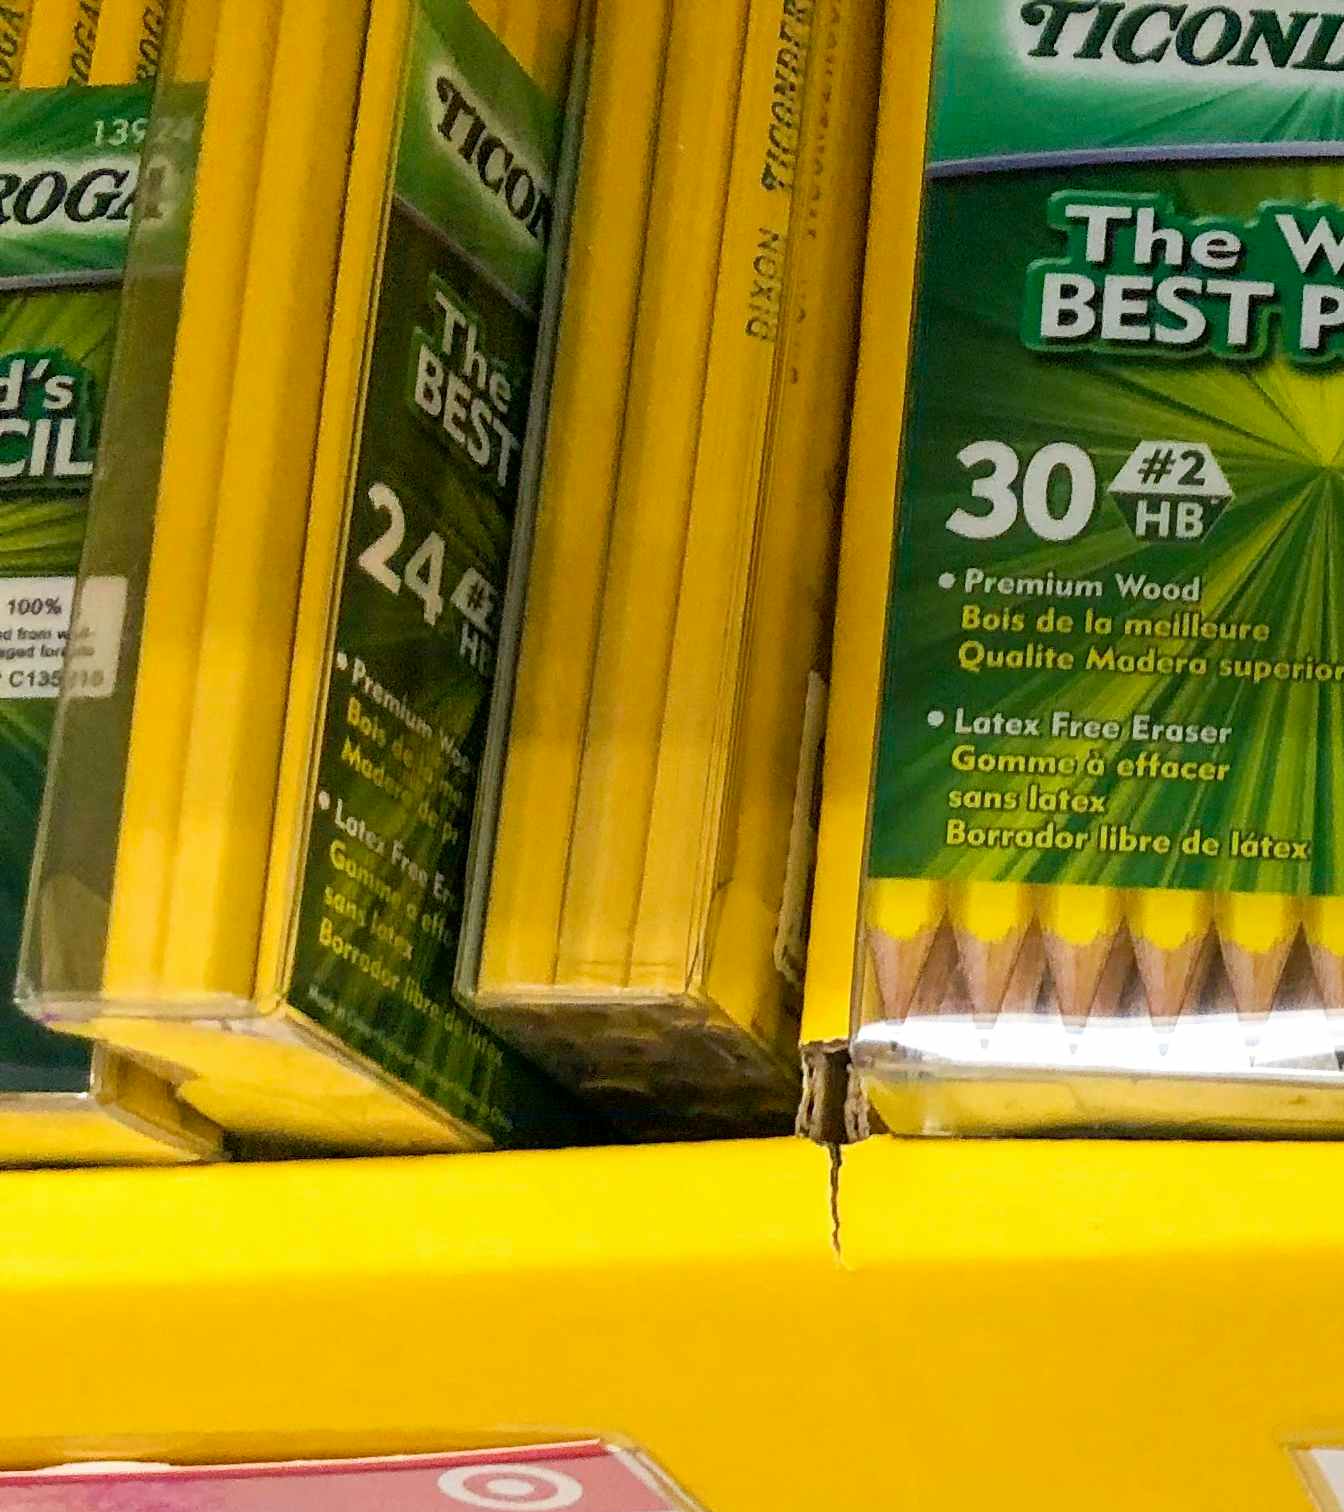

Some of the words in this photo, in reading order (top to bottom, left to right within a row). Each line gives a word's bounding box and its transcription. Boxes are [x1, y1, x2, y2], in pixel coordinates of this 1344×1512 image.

[1065, 205, 1242, 268] The
[746, 226, 782, 342] DIXON
[1039, 273, 1276, 347] BEST
[434, 290, 513, 403] The
[412, 342, 520, 488] BEST
[1138, 448, 1207, 487] #2
[945, 440, 1097, 542] 30
[1134, 501, 1205, 541] HB
[358, 482, 448, 627] 24
[964, 567, 1104, 600] Premium
[1115, 571, 1200, 602] Wood
[7, 598, 62, 617] 100%
[961, 605, 1025, 634] Bois
[1036, 607, 1074, 636] de
[1085, 609, 1113, 638] la
[1124, 611, 1270, 643] meilleure
[958, 640, 1074, 673] Qualite
[1085, 646, 1207, 677] Madera
[352, 656, 434, 739] Premium
[954, 707, 1039, 737] Latex
[1051, 711, 1120, 740] Free
[1131, 716, 1232, 745] Eraser
[951, 747, 1076, 777] Gomme
[1117, 755, 1231, 783] effacer
[948, 786, 1018, 812] sans
[1028, 784, 1106, 814] latex
[946, 819, 1087, 853] Borrador
[1099, 824, 1170, 855] libre
[1181, 827, 1219, 857] de
[1230, 829, 1311, 862] látex
